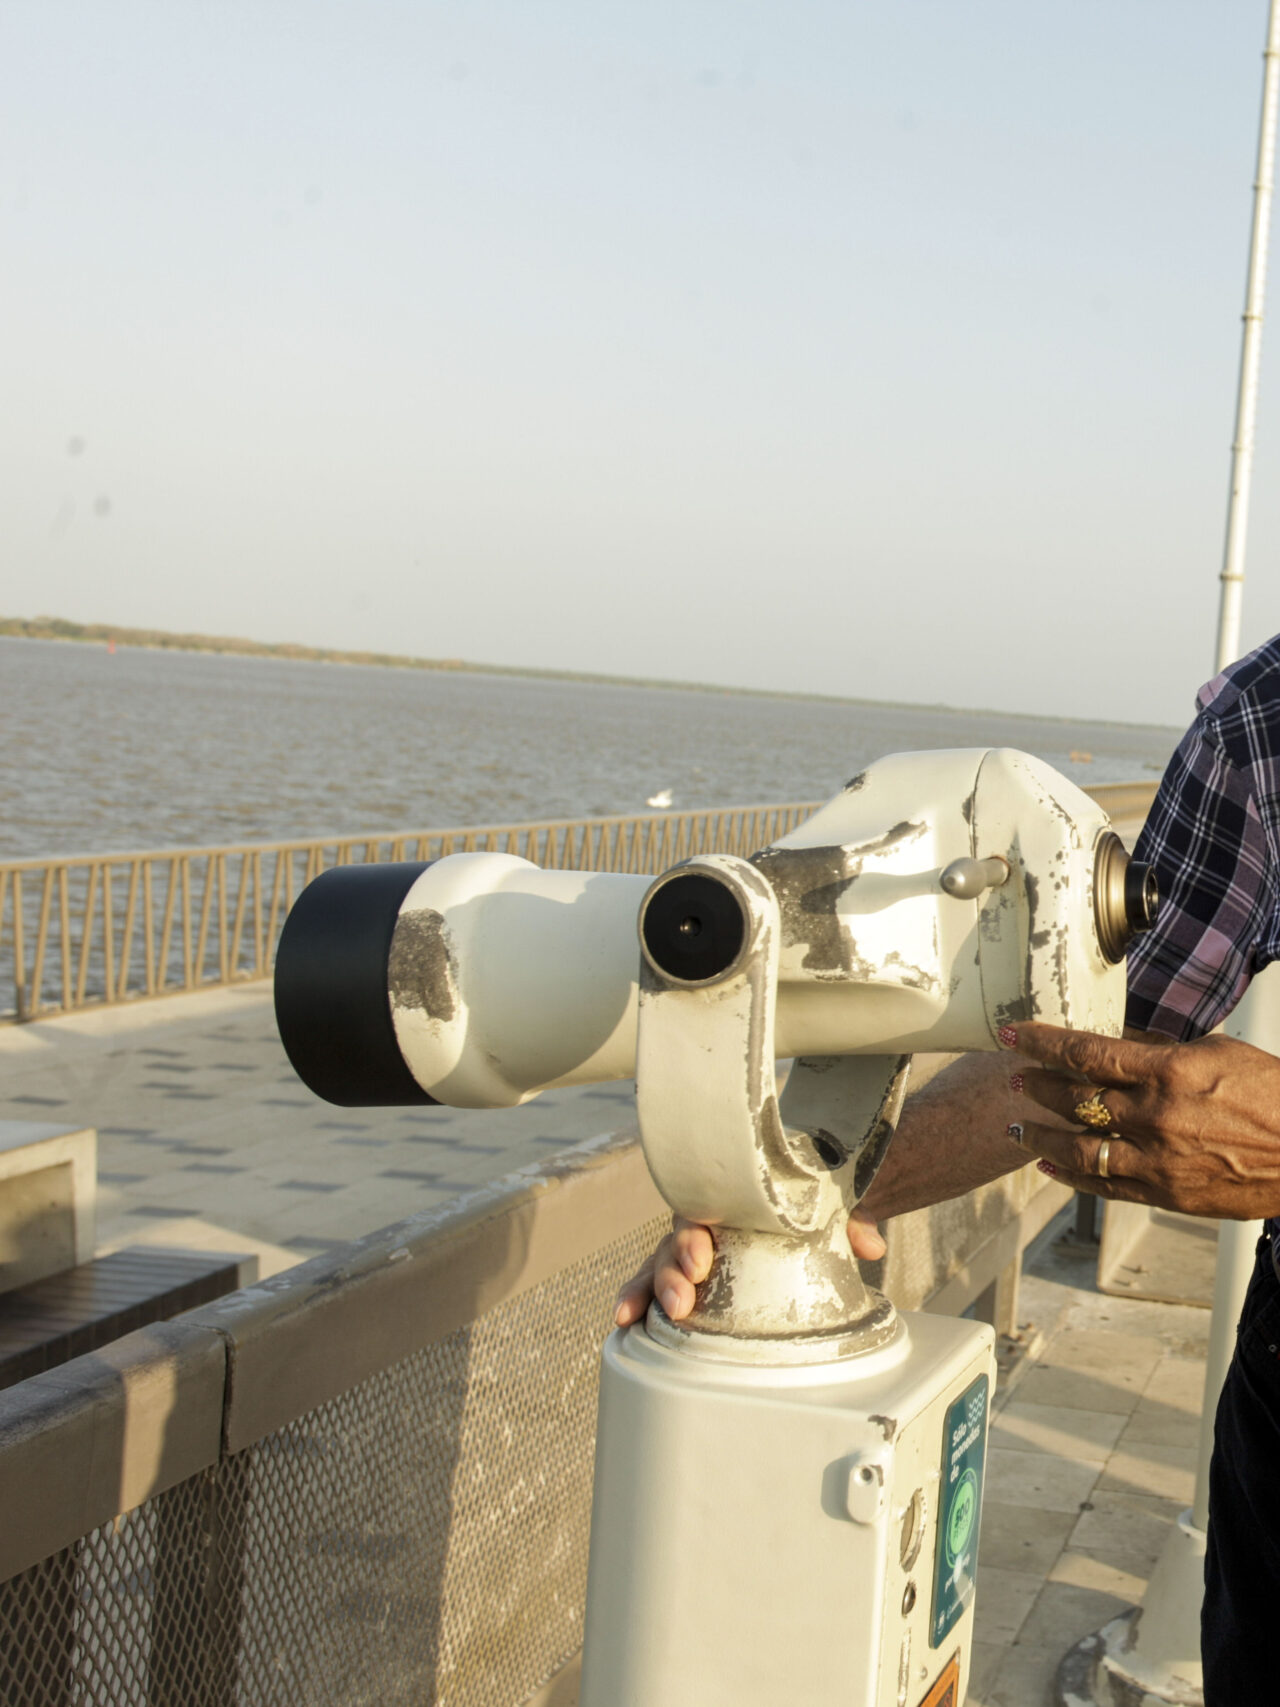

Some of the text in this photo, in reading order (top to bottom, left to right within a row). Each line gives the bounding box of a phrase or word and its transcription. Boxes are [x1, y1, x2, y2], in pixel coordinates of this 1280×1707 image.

[951, 1422, 967, 1447] Sólo
[951, 1424, 980, 1465] monedas
[950, 1464, 960, 1483] de
